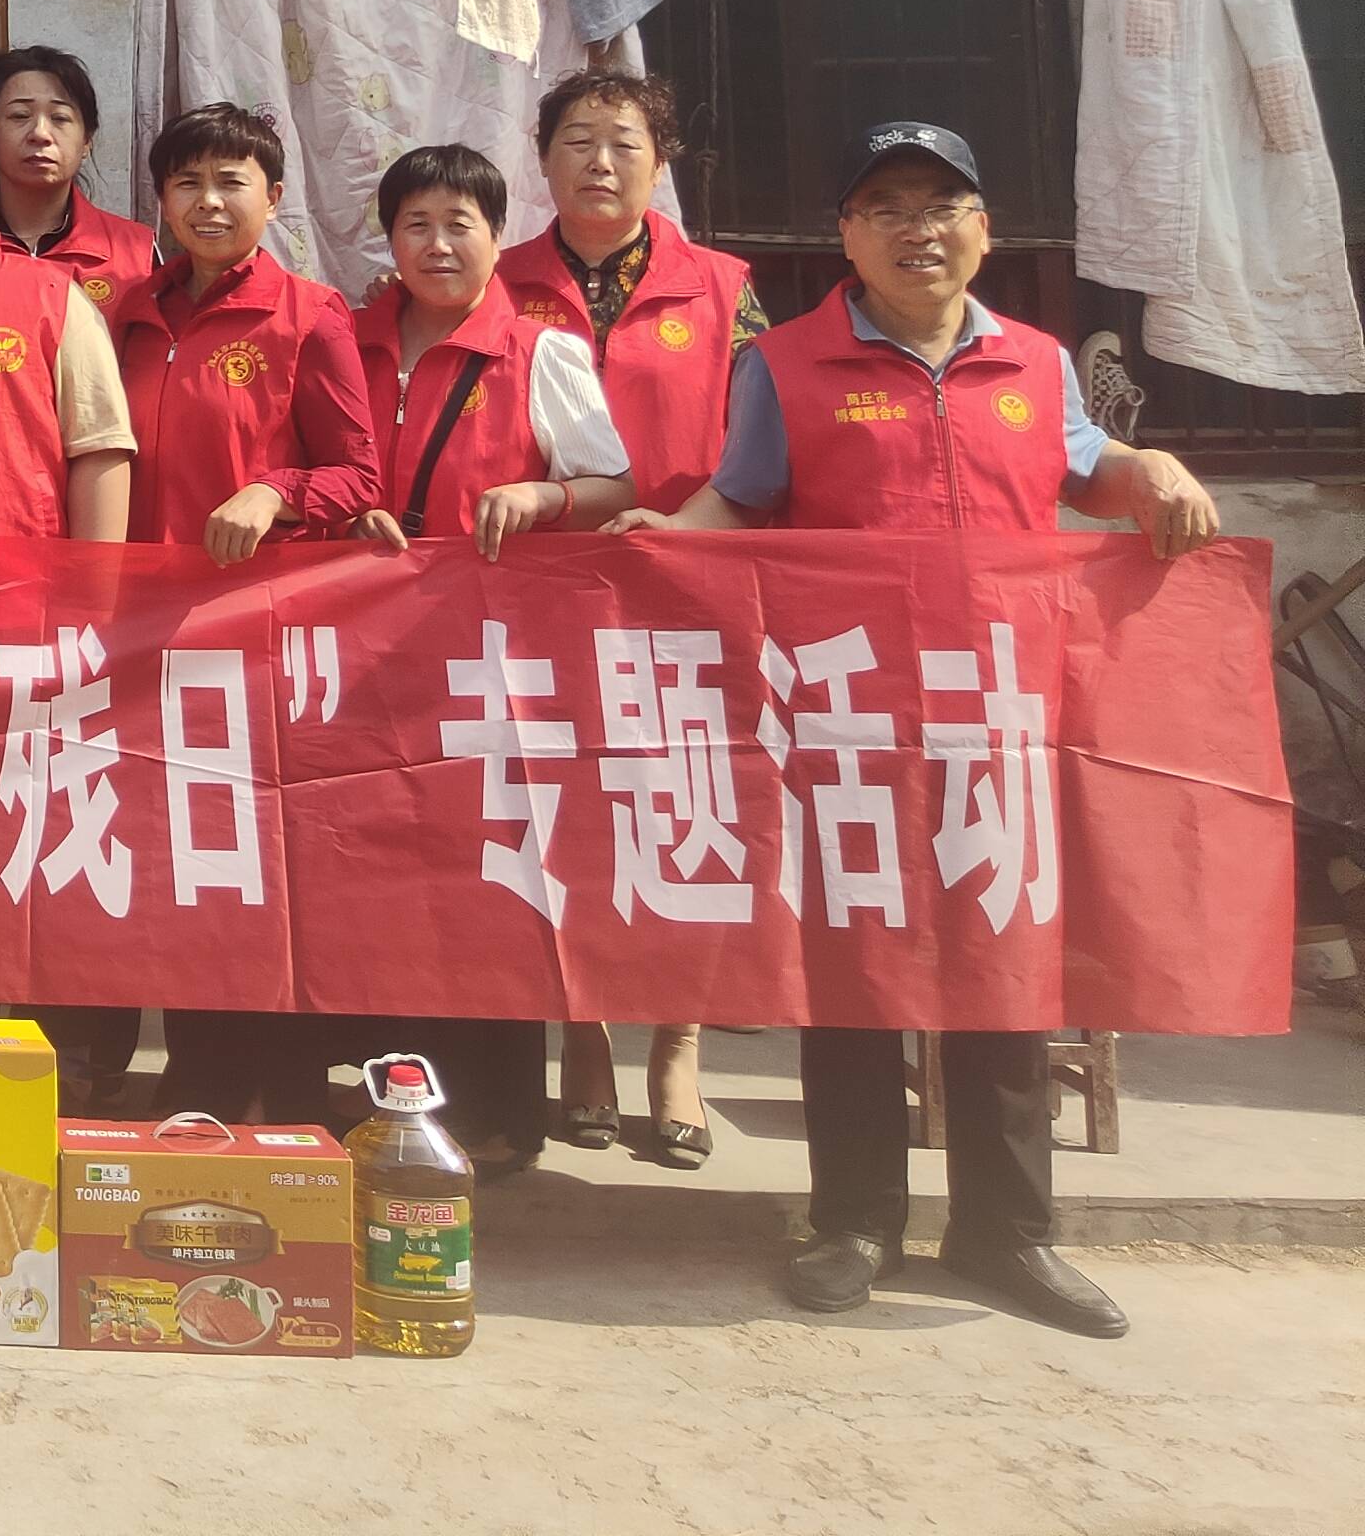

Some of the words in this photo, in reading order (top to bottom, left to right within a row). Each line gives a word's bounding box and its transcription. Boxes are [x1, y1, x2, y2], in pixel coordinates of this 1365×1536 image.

[844, 390, 889, 406] 商丘市
[834, 405, 908, 424] 博爱联合会
[75, 1187, 141, 1203] TONGBAO
[386, 1201, 456, 1225] 金龙鱼
[155, 1224, 252, 1245] 美味午餐肉
[171, 1247, 236, 1261] 单片独立包装
